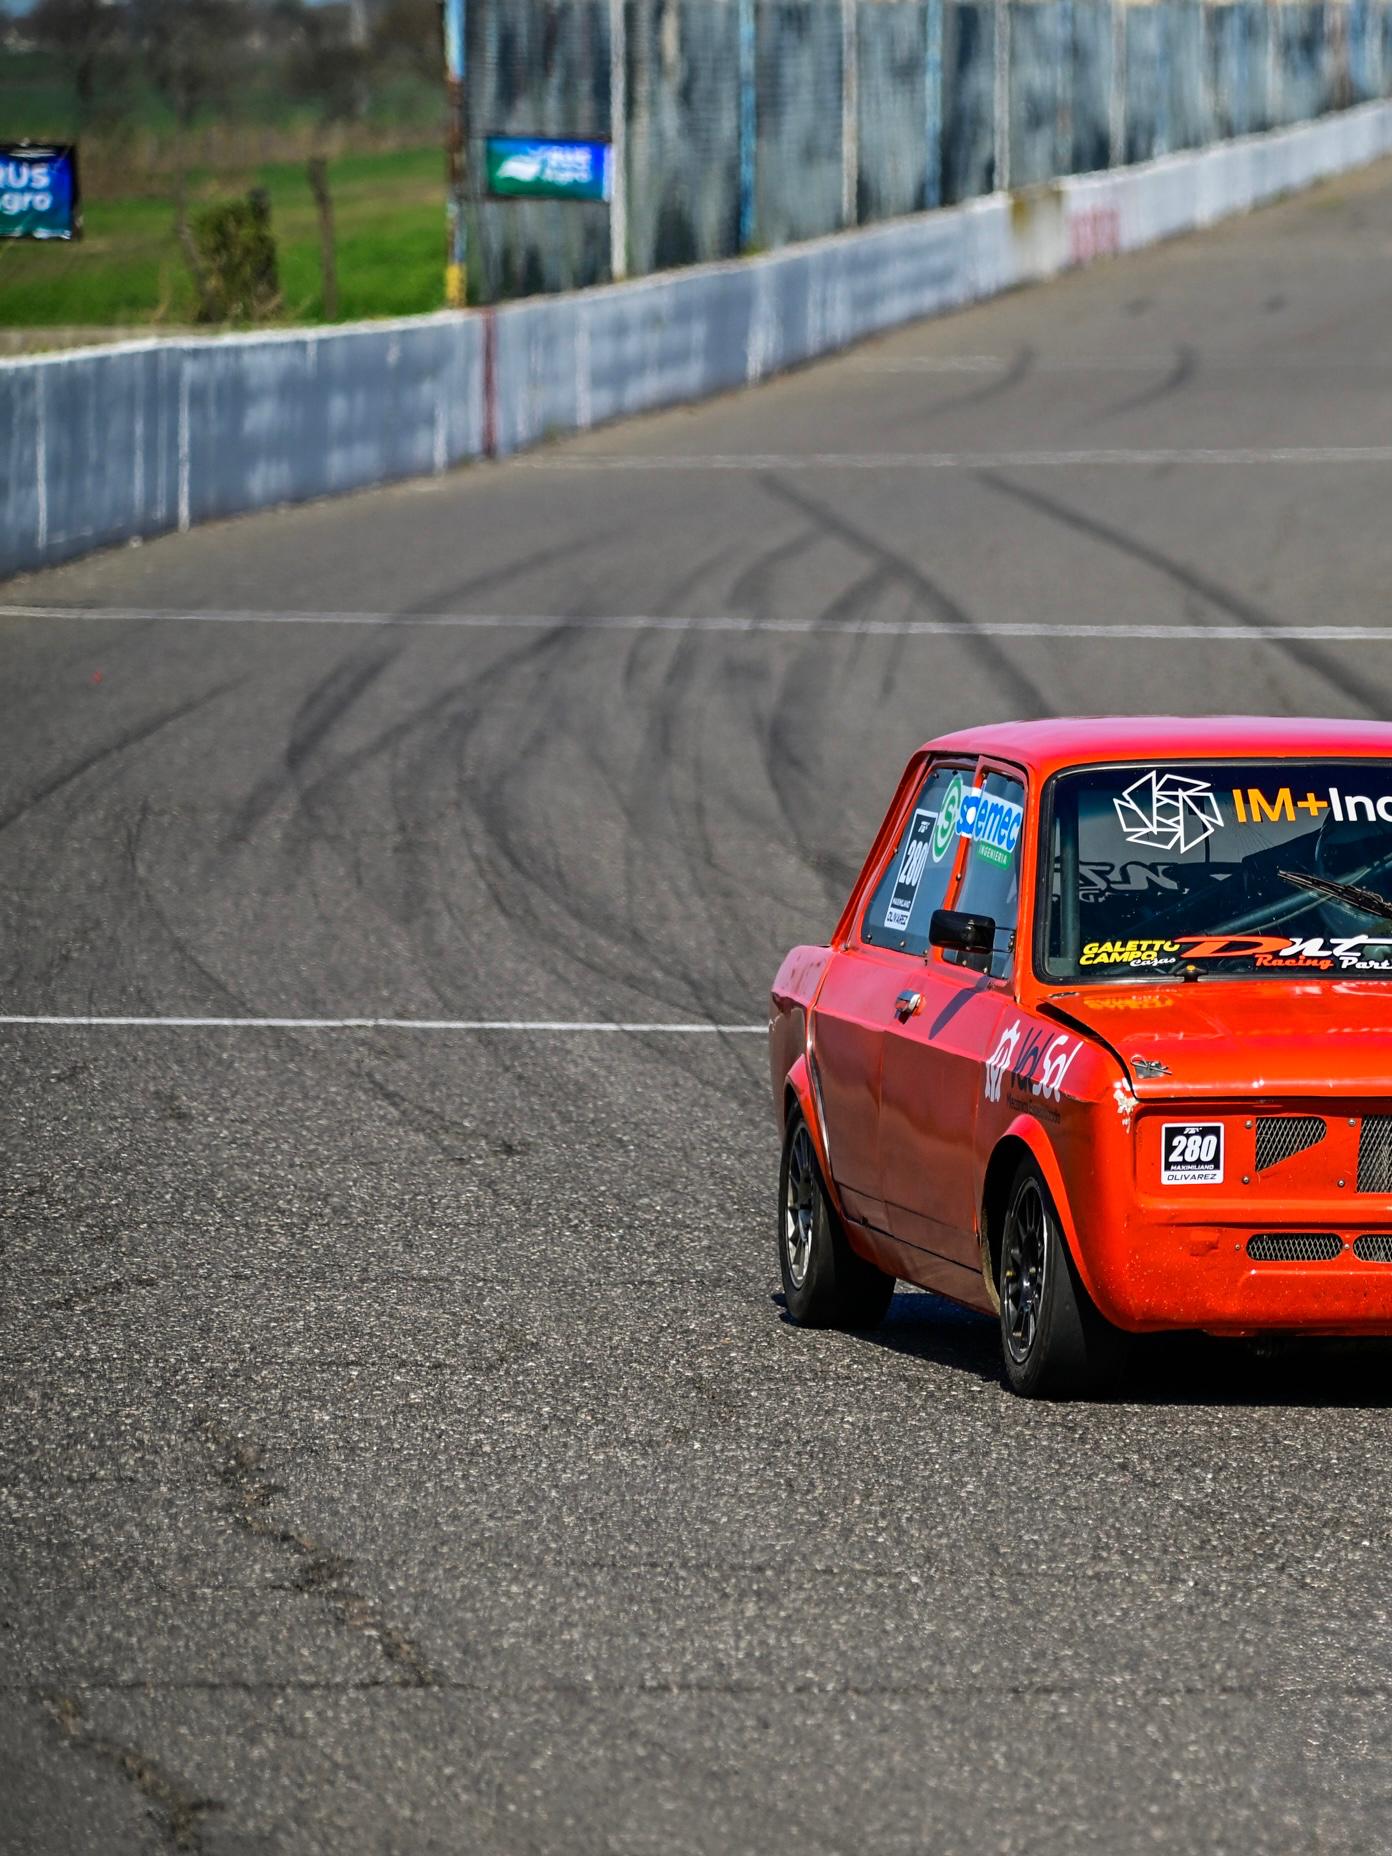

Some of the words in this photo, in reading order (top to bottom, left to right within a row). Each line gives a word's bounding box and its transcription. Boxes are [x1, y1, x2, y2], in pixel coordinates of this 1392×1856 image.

[899, 840, 930, 886] 280
[1083, 940, 1180, 954] GALETTO
[1079, 951, 1157, 965] CAMPO
[1255, 954, 1334, 970] Racing
[1168, 1135, 1218, 1162] 280
[1167, 1173, 1217, 1181] OLIVAREZ
